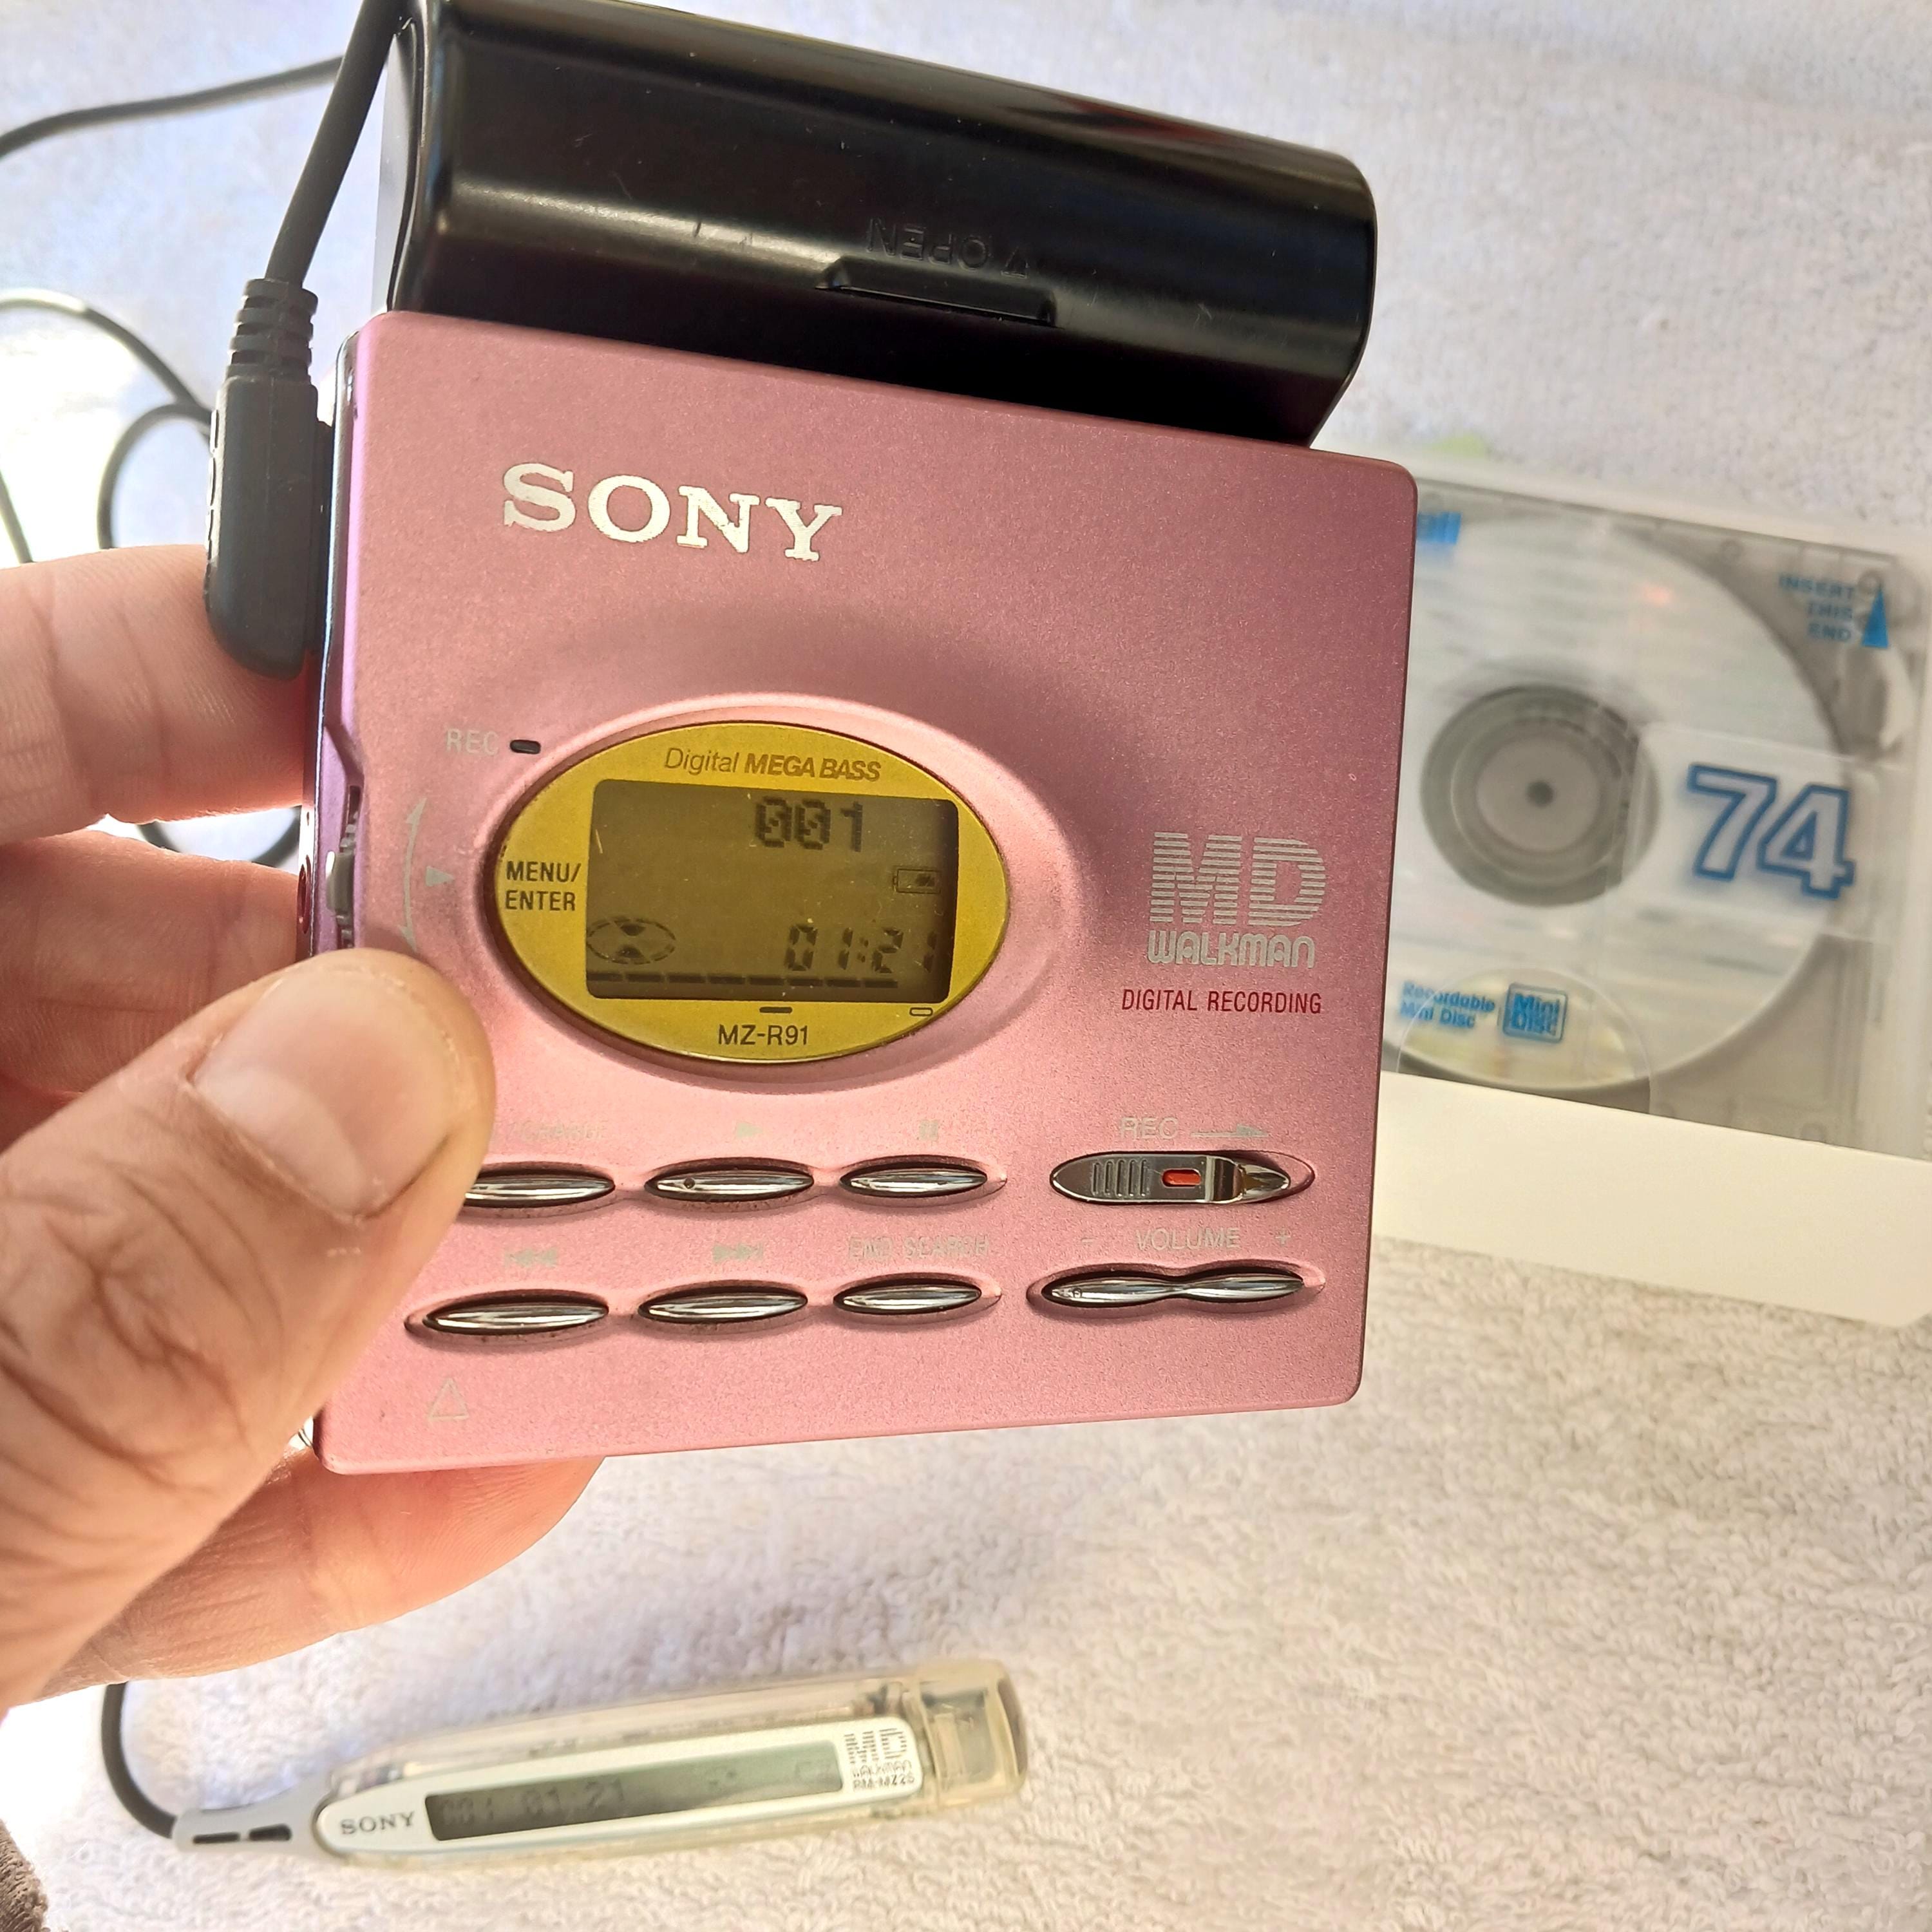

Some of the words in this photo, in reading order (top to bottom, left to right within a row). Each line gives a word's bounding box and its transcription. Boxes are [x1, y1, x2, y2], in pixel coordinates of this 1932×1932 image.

[866, 217, 990, 271] OPEN
[502, 462, 842, 562] SONY
[1778, 574, 1855, 600] INSERT
[1807, 601, 1853, 620] THIS
[1807, 622, 1851, 641] END
[445, 728, 499, 756] REC
[664, 747, 740, 775] Digital
[744, 752, 816, 778] MEGA
[819, 758, 882, 782] BASS
[755, 796, 864, 852] 001
[1685, 762, 1855, 900] 74
[506, 861, 582, 884] MENU/
[1150, 831, 1327, 927] MD
[505, 889, 576, 912] ENTER
[783, 923, 937, 974] 01:21
[1148, 929, 1316, 969] WALKMAN
[1122, 989, 1198, 1011] DIGITAL
[1207, 990, 1322, 1014] RECORDING
[1401, 980, 1495, 1012] Recordable
[1439, 1007, 1475, 1028] Disc
[718, 1023, 810, 1046] MZ-R91
[1119, 1117, 1179, 1140] REC
[904, 1234, 990, 1257] SEARCH
[1135, 1227, 1242, 1251] VOLUME
[844, 1728, 907, 1764] MD
[340, 1811, 415, 1835] SONY
